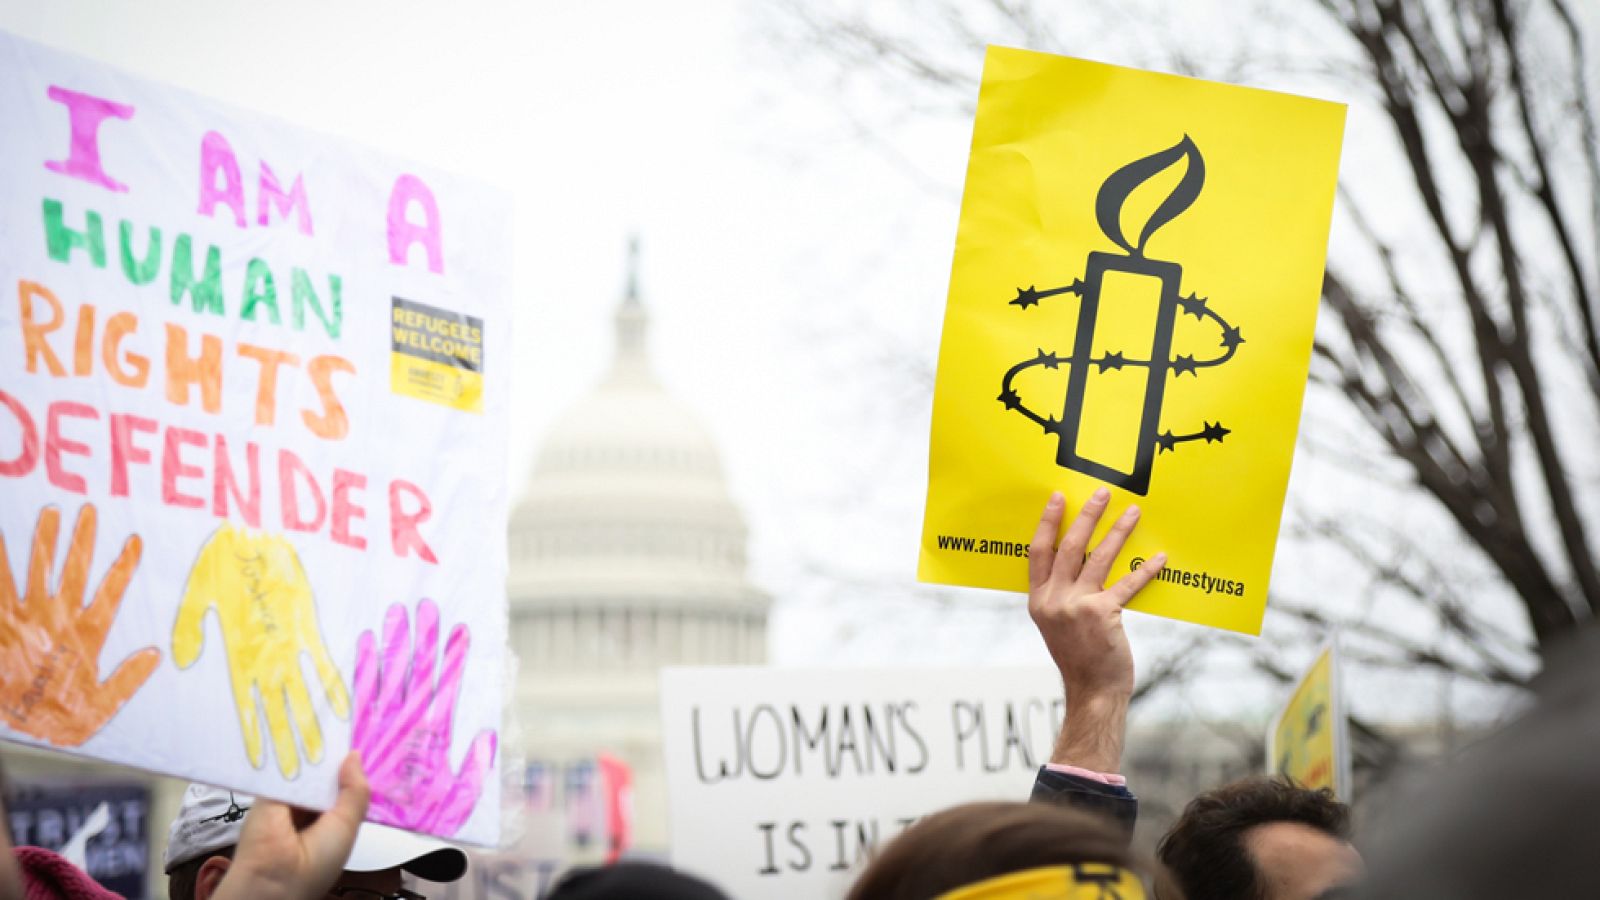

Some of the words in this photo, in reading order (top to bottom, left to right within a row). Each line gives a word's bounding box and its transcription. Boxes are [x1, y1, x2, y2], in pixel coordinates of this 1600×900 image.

[44, 85, 134, 193] I
[197, 130, 314, 236] AM
[386, 173, 444, 275] A
[42, 197, 342, 339] HUMAN
[18, 279, 356, 441] RIGHTS
[393, 306, 481, 344] REFUGEES
[393, 328, 481, 366] WELCOME
[691, 699, 929, 784] WOMAN'S
[756, 821, 812, 876] IS
[828, 817, 879, 872] IN
